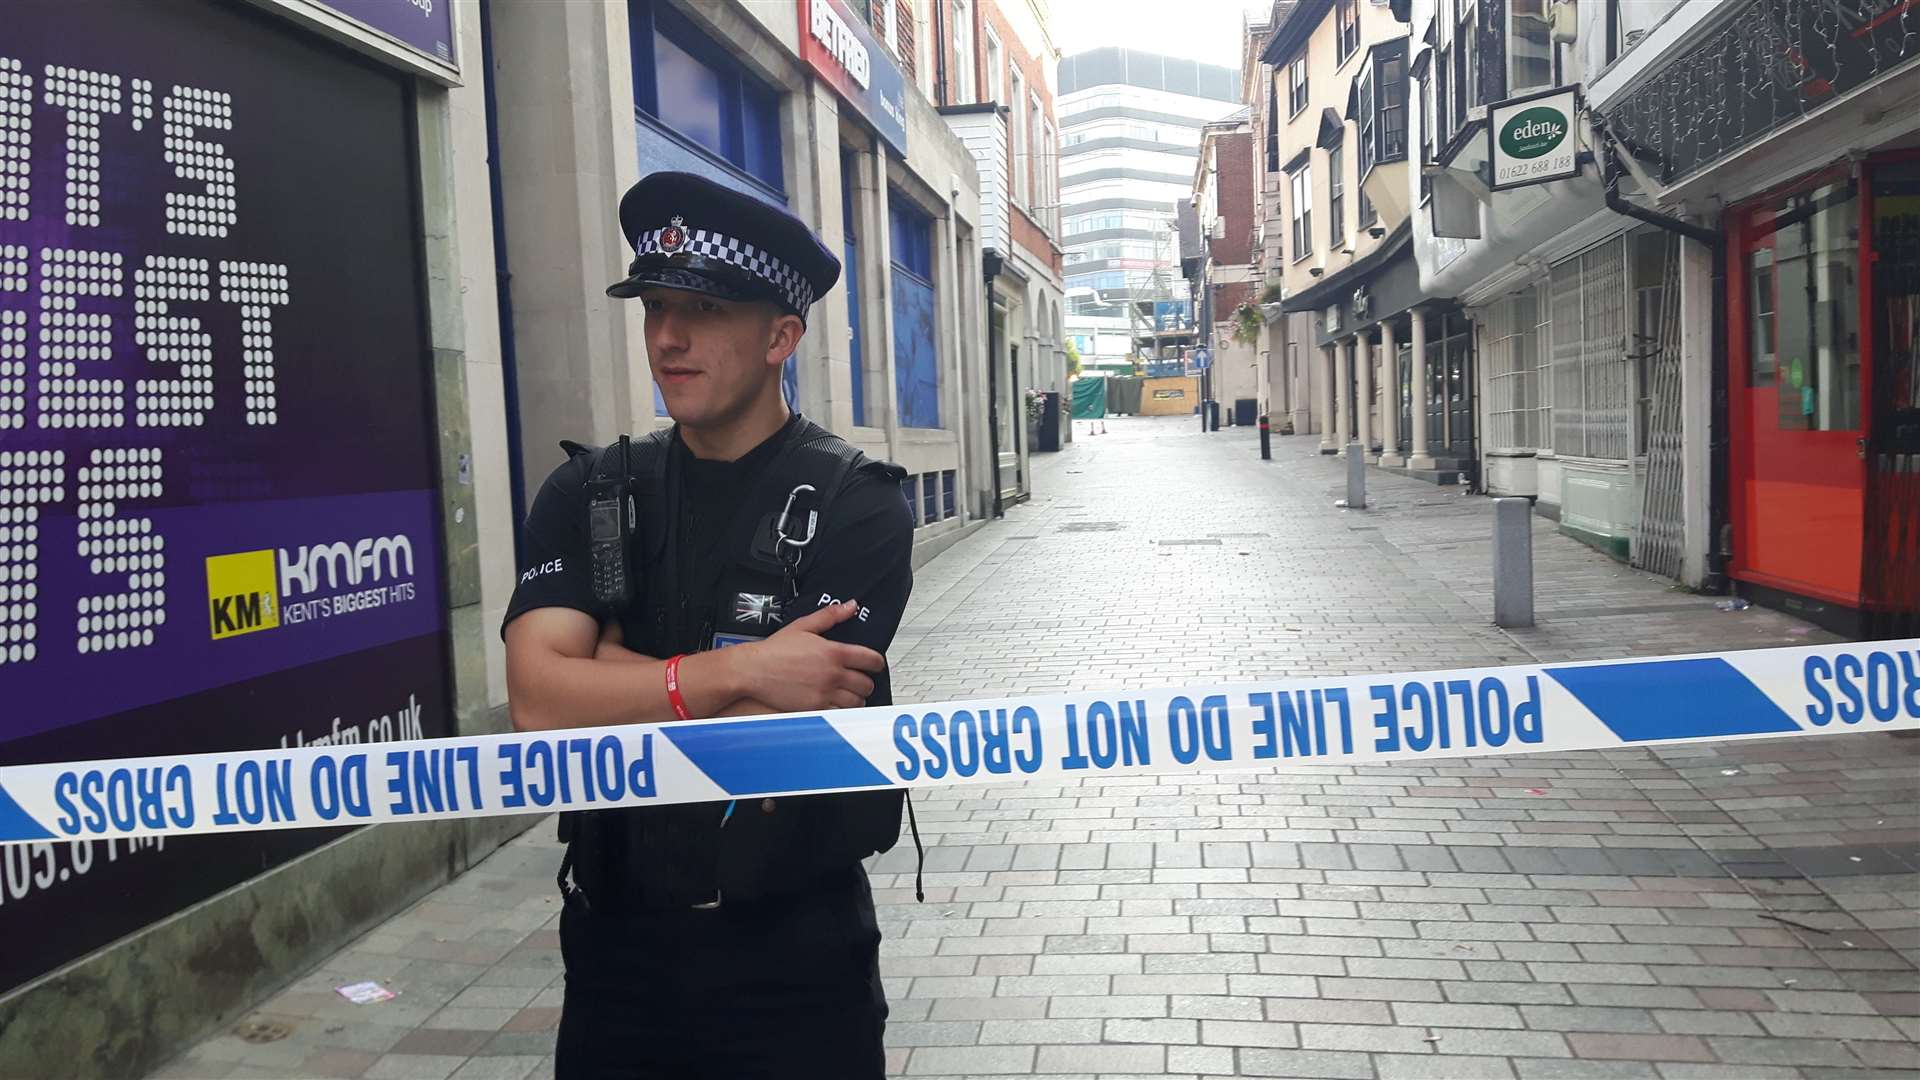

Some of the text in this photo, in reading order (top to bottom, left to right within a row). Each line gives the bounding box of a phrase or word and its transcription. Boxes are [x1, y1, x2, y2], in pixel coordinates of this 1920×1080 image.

[811, 0, 870, 90] BETFRED
[1513, 120, 1551, 140] eden
[1499, 163, 1528, 180] 01622
[1531, 159, 1550, 174] 688
[212, 591, 262, 635] KM
[283, 597, 331, 625] KENT'S
[333, 587, 387, 615] BIGGEST
[389, 582, 415, 603] HITS
[893, 675, 1544, 782] POLICE LINE DO NOT CROSS
[54, 733, 658, 836] POLICE LINE DO NOT CROSS
